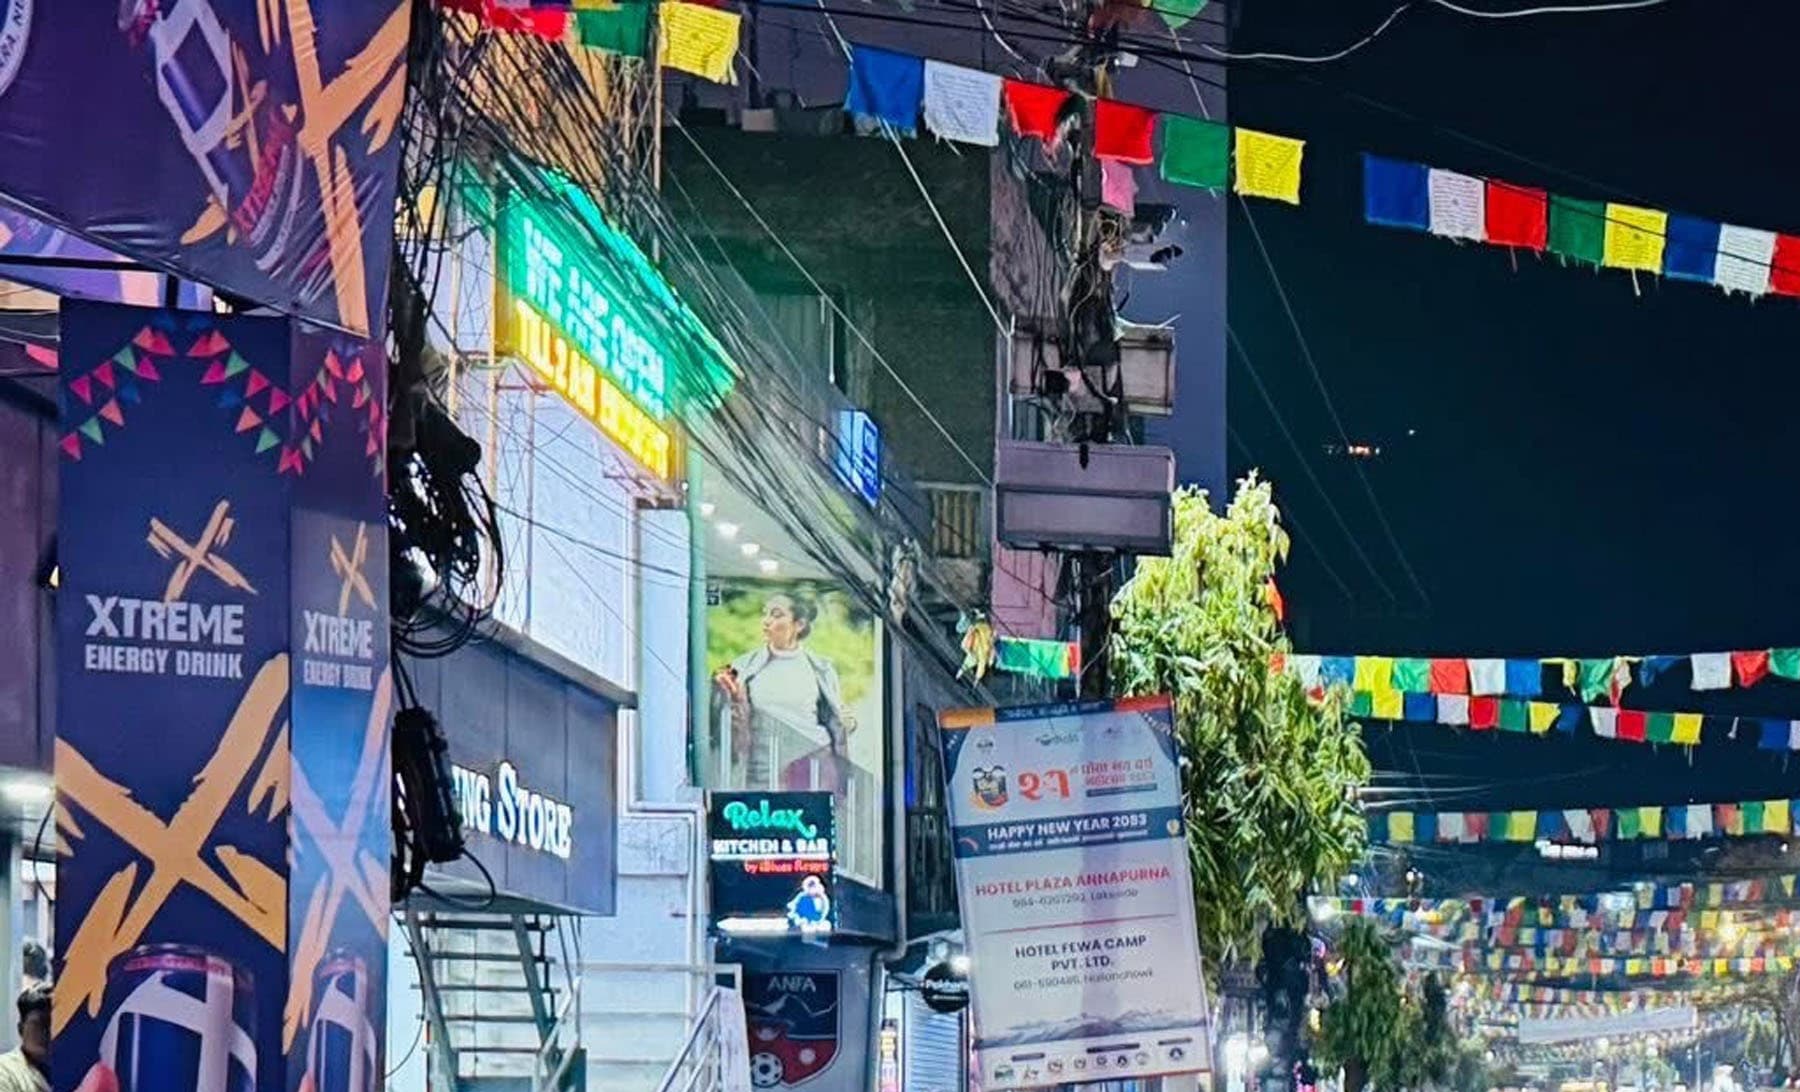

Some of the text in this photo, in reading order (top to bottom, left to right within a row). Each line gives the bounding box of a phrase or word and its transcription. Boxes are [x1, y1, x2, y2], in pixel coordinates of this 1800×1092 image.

[84, 594, 244, 645] XTREME
[303, 610, 373, 659] XTREME
[85, 644, 243, 679] ENERGY DRINK
[303, 660, 373, 690] ENERGY DRINK
[723, 799, 817, 838] Relax
[987, 823, 1036, 841] HAPPY
[1038, 820, 1070, 836] NEW
[1073, 816, 1110, 832] YEAR
[781, 839, 793, 853] &
[796, 838, 828, 853] BAR
[975, 867, 1171, 897] HOTEL PLAZA ANNAPURNA
[1015, 934, 1147, 959] HOTEL FEWA CAMP
[767, 975, 817, 993] ANFA
